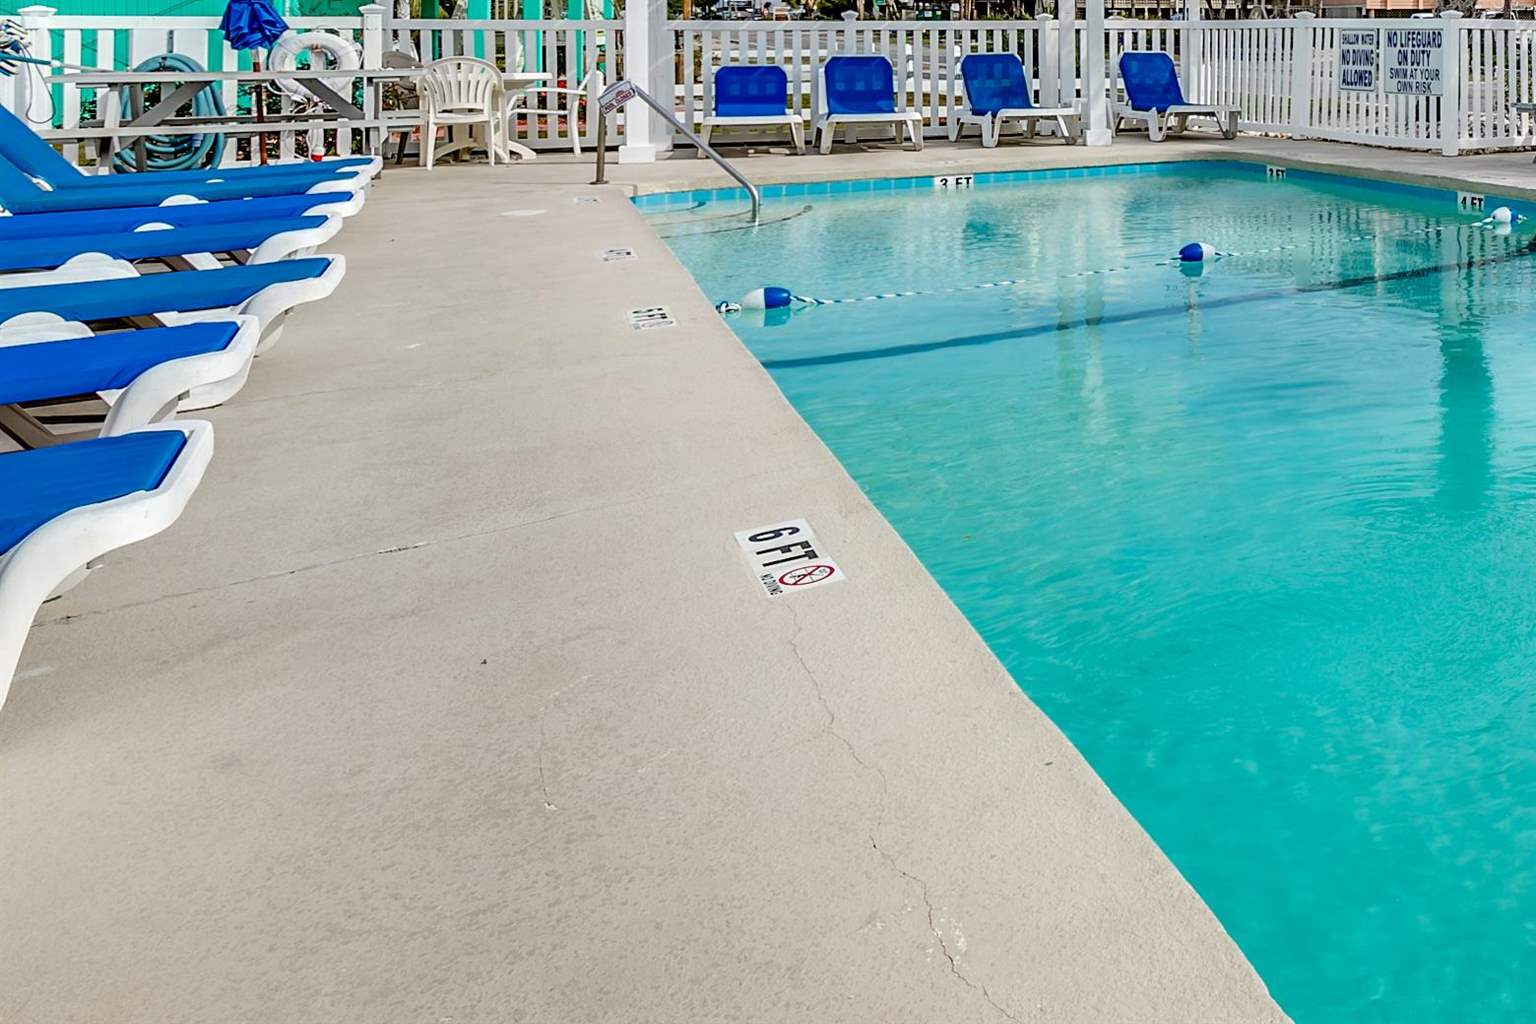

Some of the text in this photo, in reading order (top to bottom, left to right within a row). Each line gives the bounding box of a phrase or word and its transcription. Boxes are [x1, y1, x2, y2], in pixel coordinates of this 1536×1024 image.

[1342, 34, 1374, 45] SHALLOW WATER
[1387, 32, 1442, 48] NO LIFEGUARD
[1342, 49, 1374, 66] NO DIVING
[1397, 50, 1431, 66] ON DUTY
[1342, 69, 1372, 86] ALLOWED
[1390, 68, 1440, 80] SWIM AT YOUR
[1397, 81, 1432, 93] OWN RISK
[748, 527, 819, 567] 6 FT
